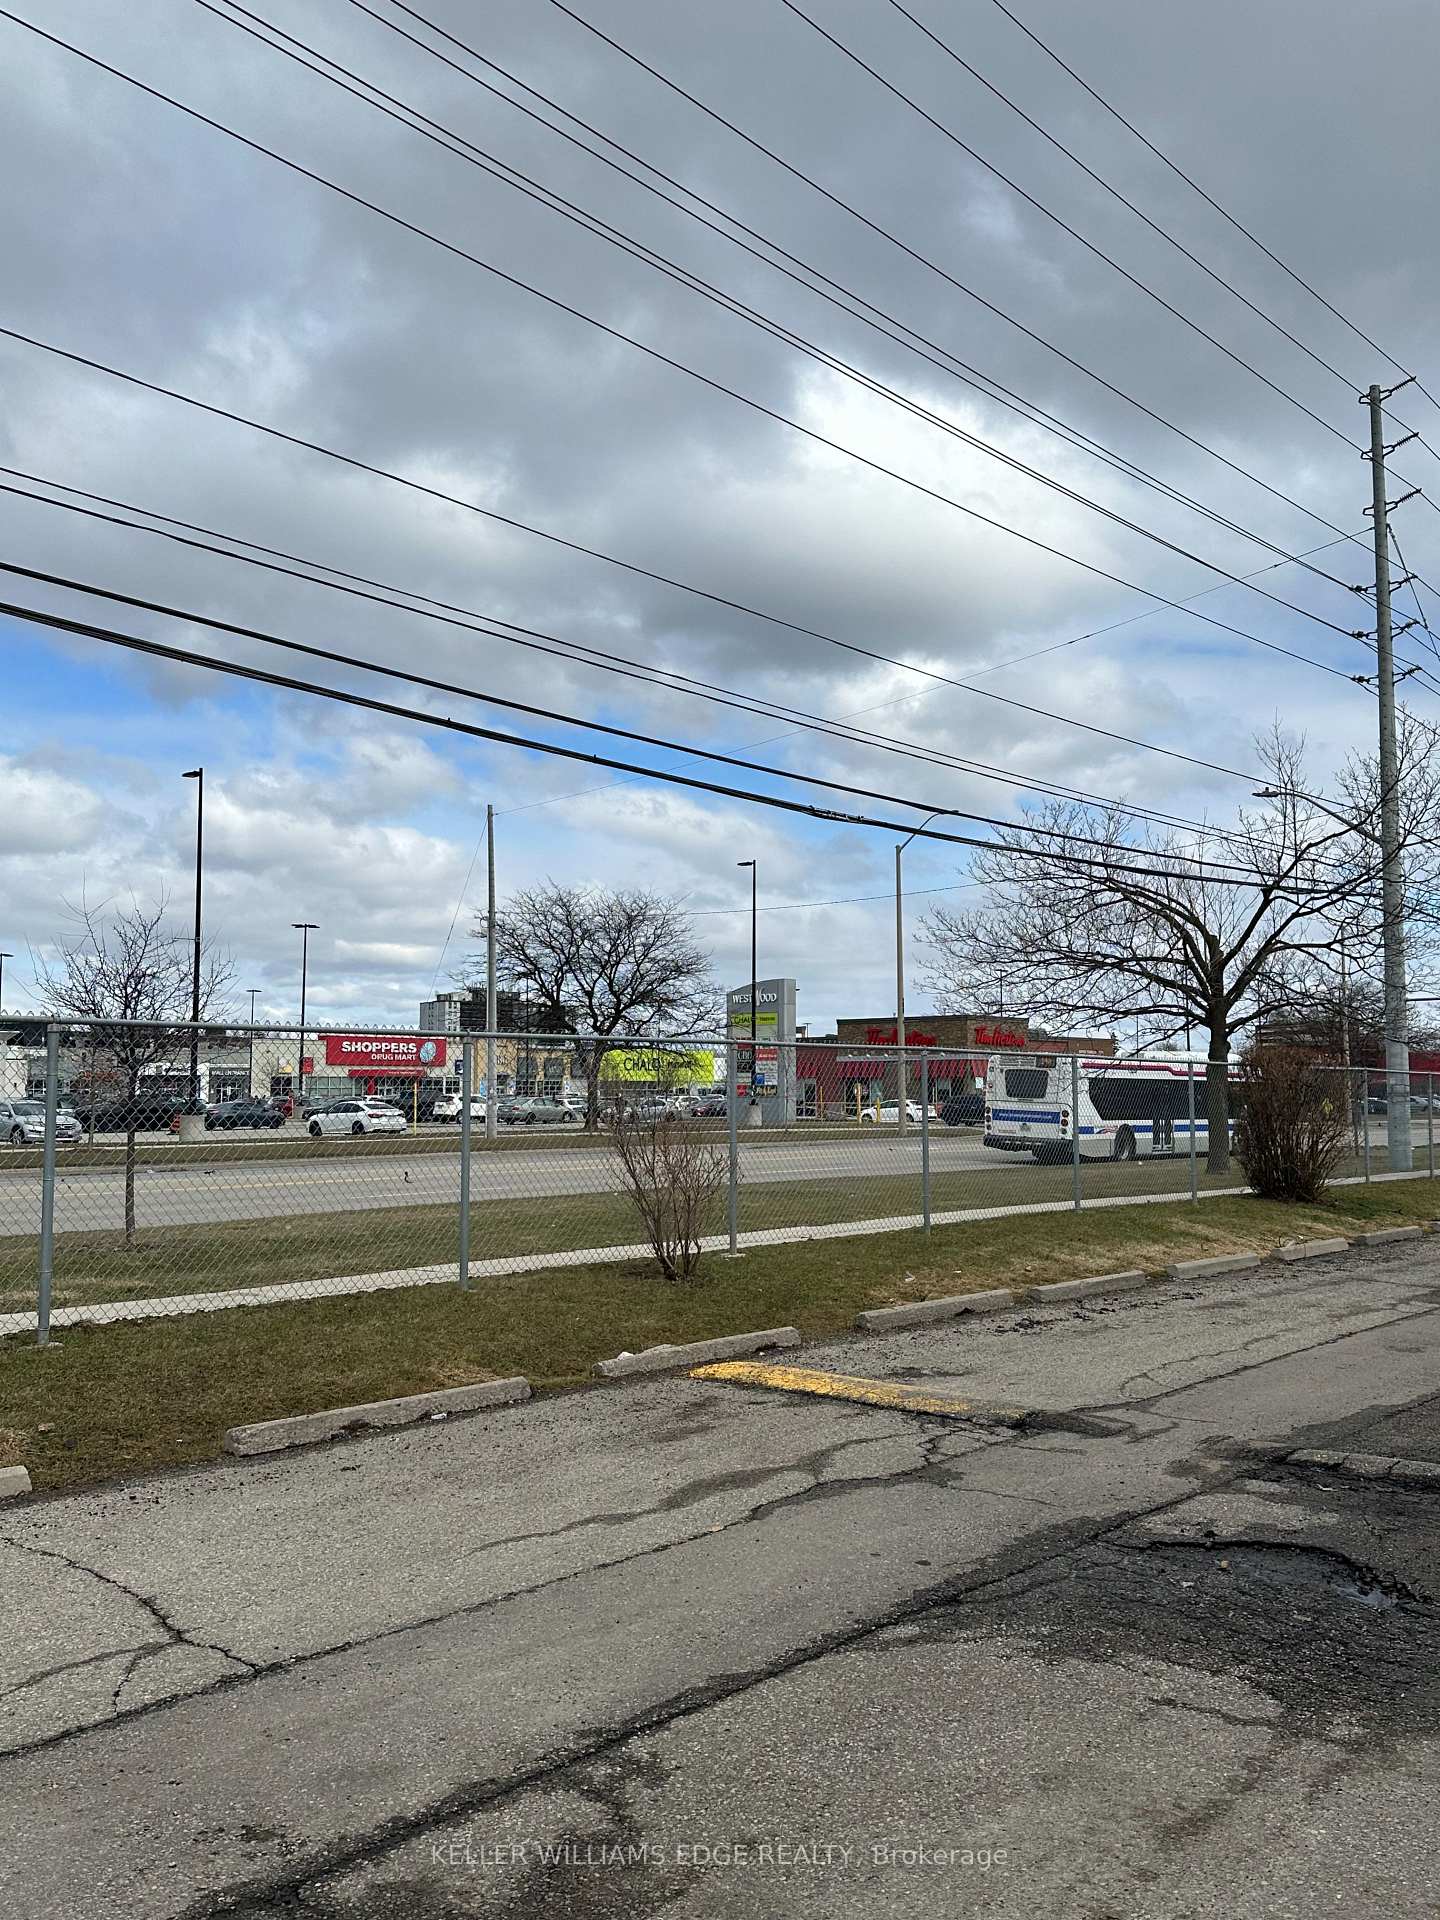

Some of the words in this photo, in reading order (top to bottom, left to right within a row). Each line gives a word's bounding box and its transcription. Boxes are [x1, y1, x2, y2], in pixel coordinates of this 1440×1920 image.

[975, 1026, 994, 1045] Tim
[992, 1025, 1025, 1047] Hortons
[341, 1041, 417, 1053] SHOPPERS
[371, 1053, 393, 1061] DRUG
